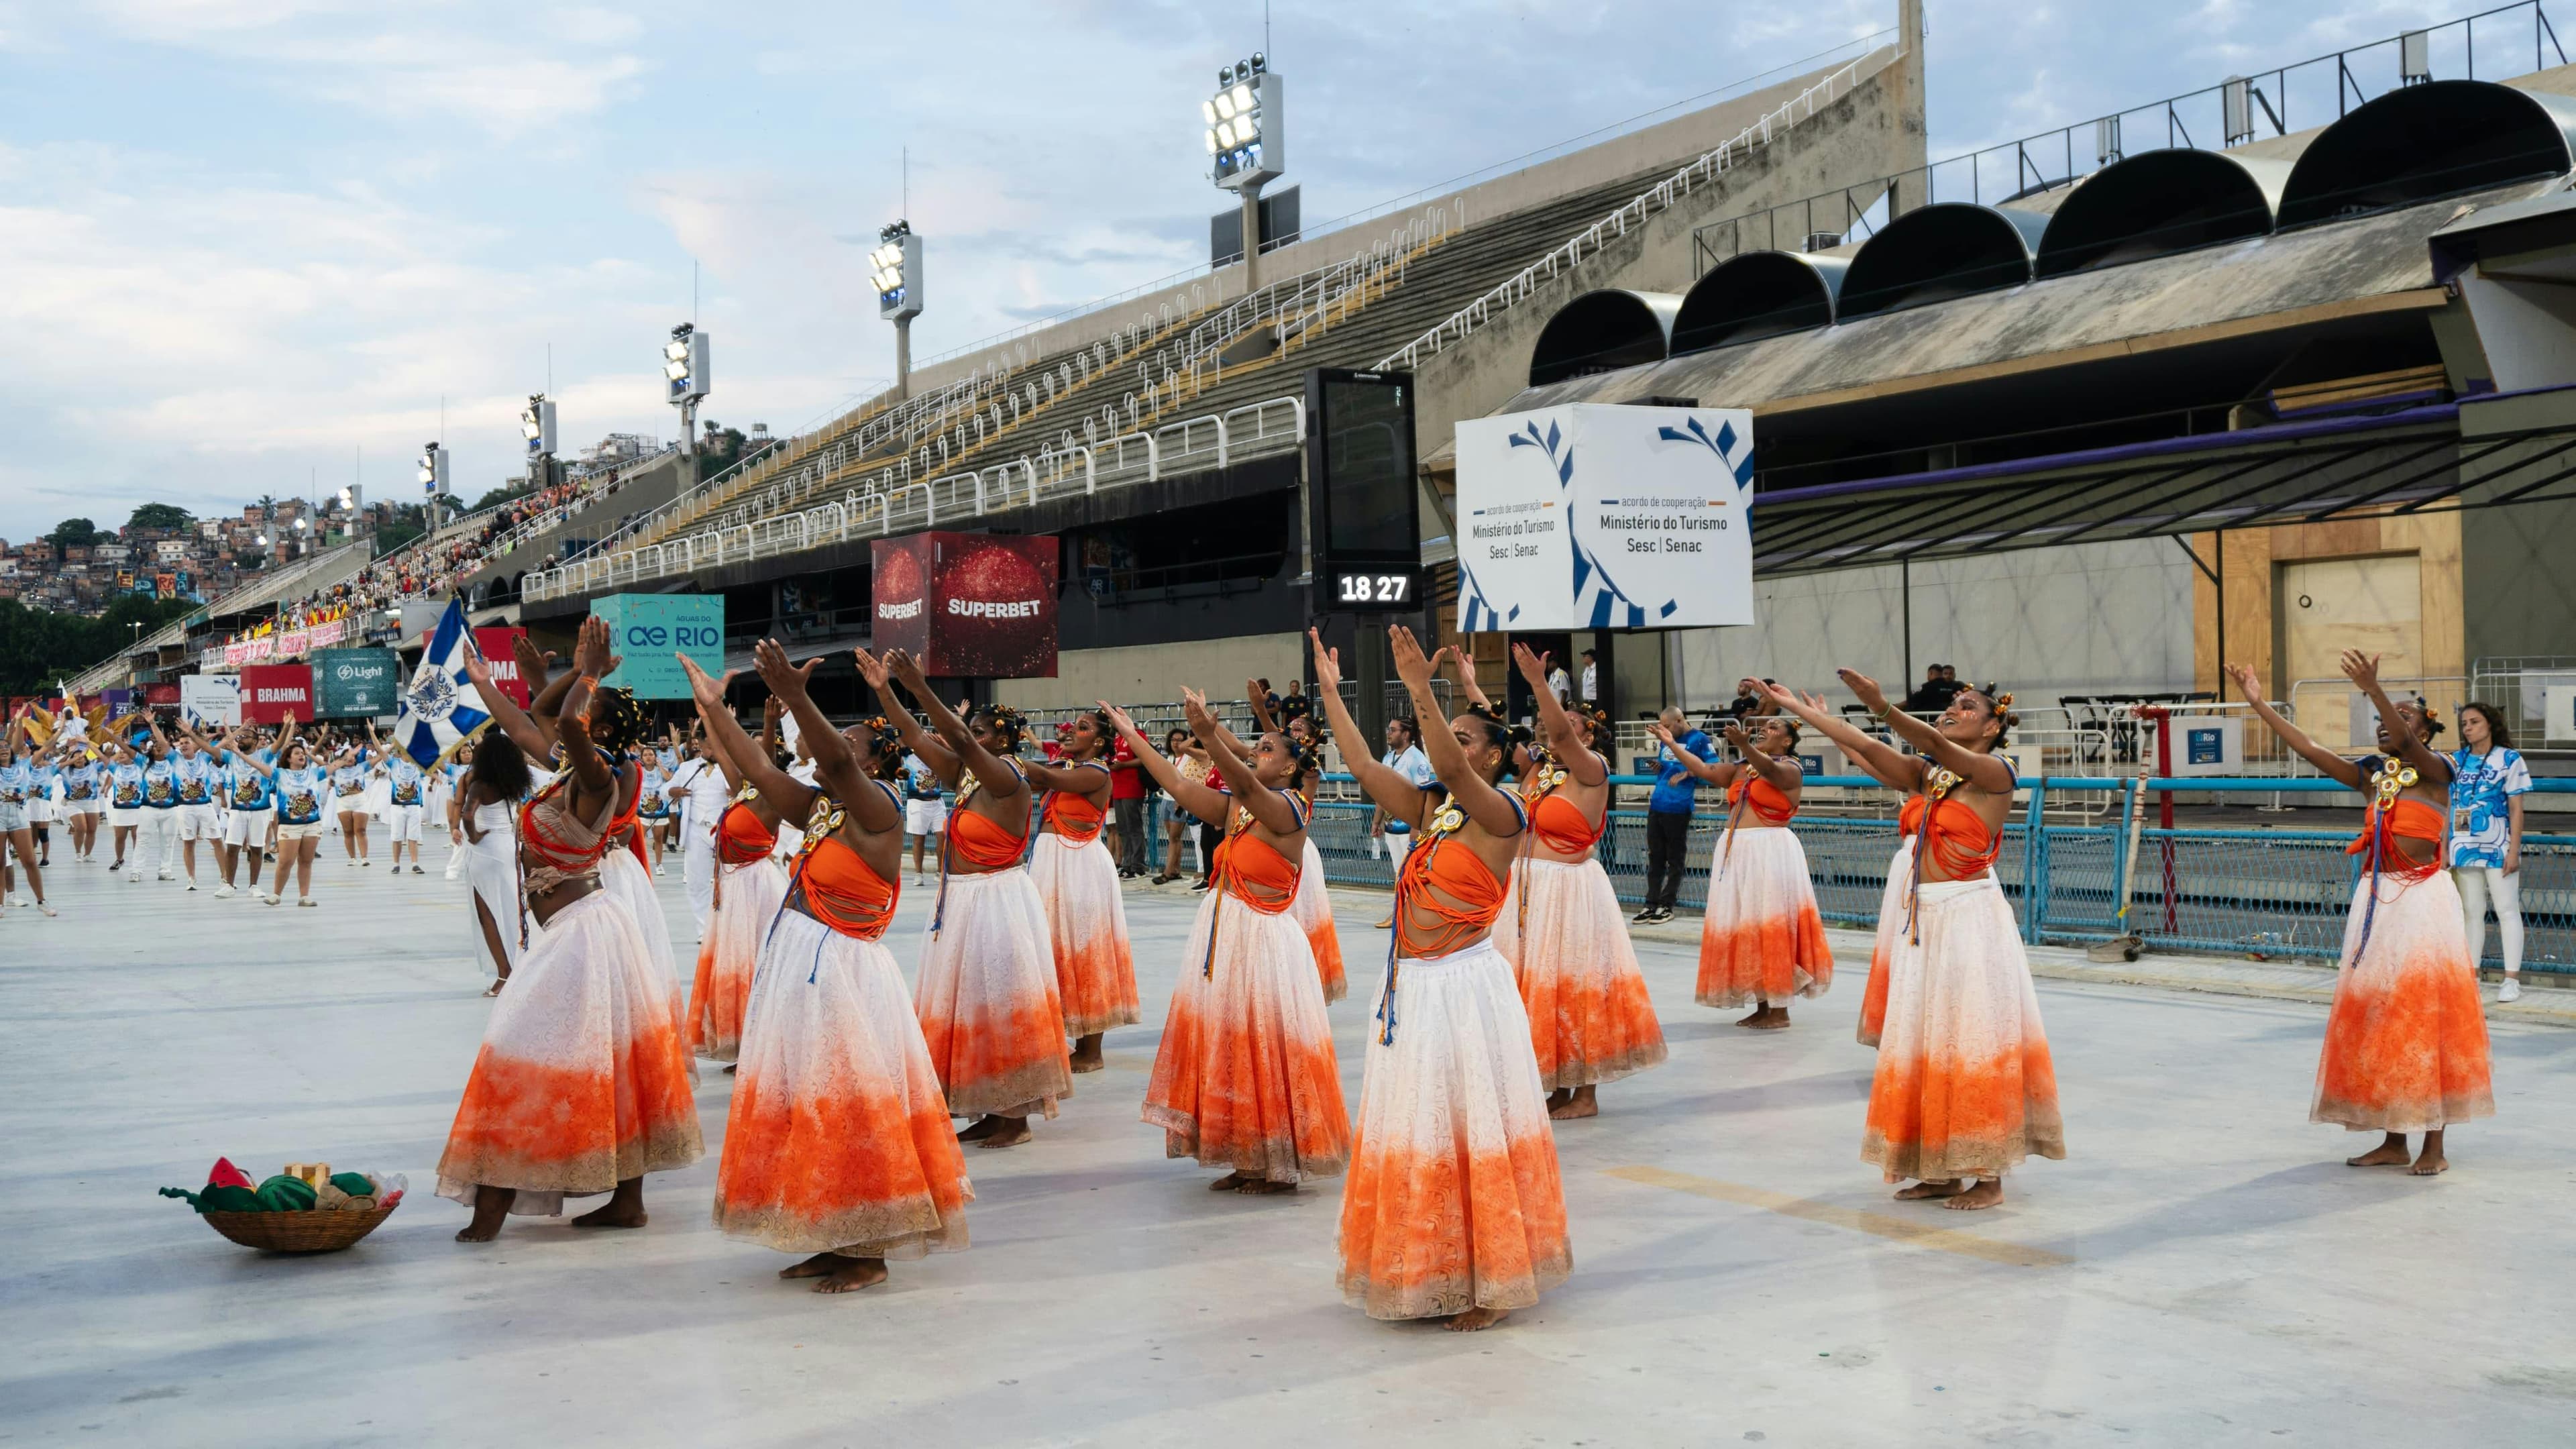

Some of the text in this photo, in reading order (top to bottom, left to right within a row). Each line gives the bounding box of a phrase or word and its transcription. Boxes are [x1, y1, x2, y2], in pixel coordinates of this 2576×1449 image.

[1486, 500, 1542, 516] acordo de cooperação
[1621, 496, 1707, 510] acordo de cooperação
[1472, 519, 1554, 539] Ministério do Turismo
[1600, 514, 1727, 531] Ministério do Turismo
[1489, 543, 1539, 559] Sesc Senac
[1627, 538, 1703, 553] Sesc Senac
[1341, 576, 1407, 601] 18 27
[878, 598, 923, 620] SUPERBET
[948, 598, 1040, 619] SUPERBET
[676, 627, 719, 647] RIO
[355, 666, 383, 679] Light
[258, 688, 306, 702] BRAHMA
[2203, 733, 2215, 742] Rio
[1805, 759, 1817, 767] Rio
